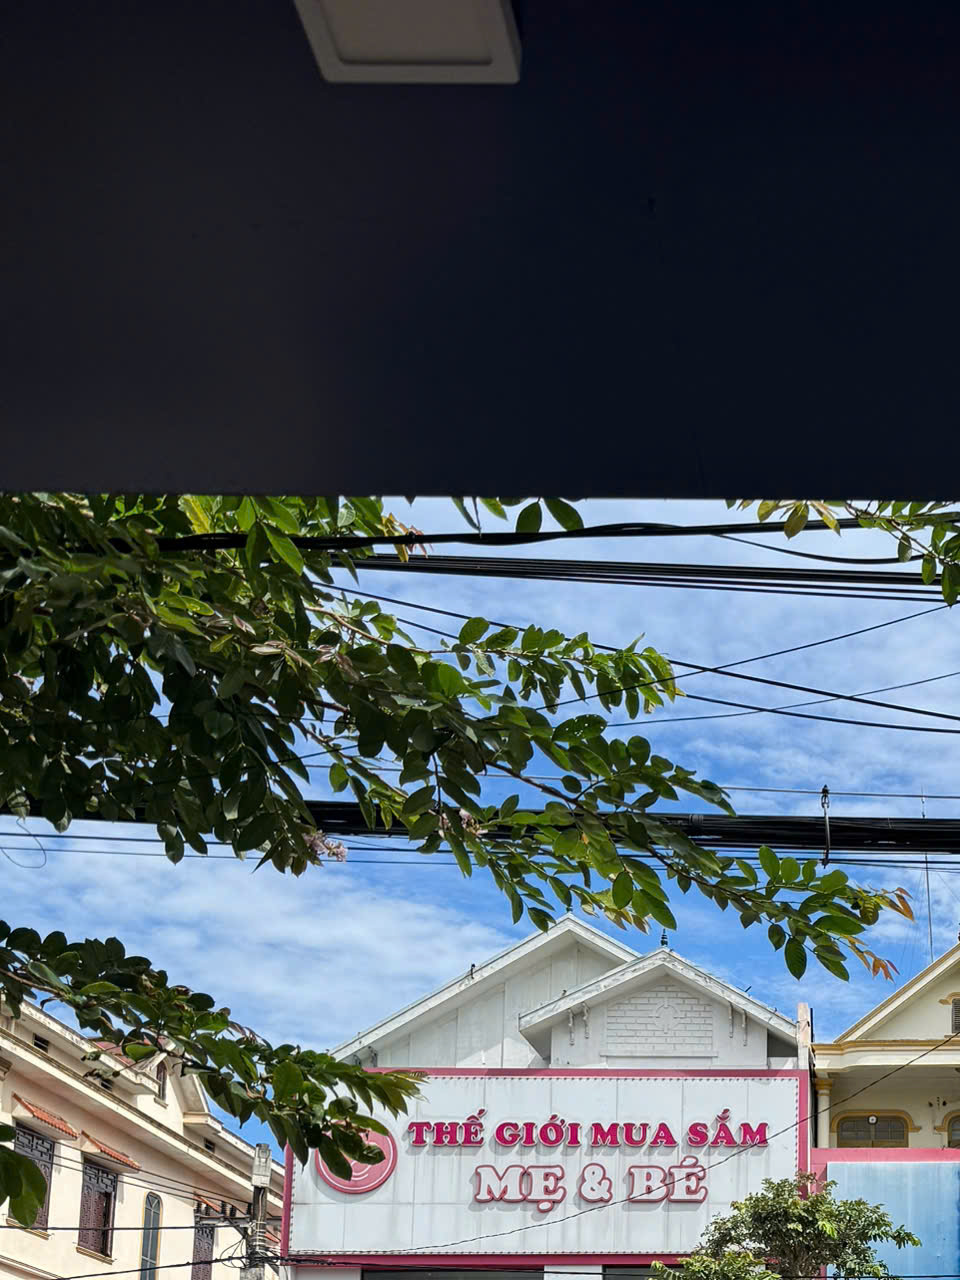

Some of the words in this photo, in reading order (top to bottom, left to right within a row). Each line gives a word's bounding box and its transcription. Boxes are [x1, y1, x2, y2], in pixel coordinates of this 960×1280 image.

[408, 1108, 485, 1148] THẾ
[494, 1114, 580, 1148] GIỚI
[591, 1121, 678, 1148] MUA
[688, 1108, 769, 1148] SẮM
[475, 1164, 567, 1213] MẸ
[579, 1162, 613, 1202] &
[628, 1156, 708, 1203] BÉ
